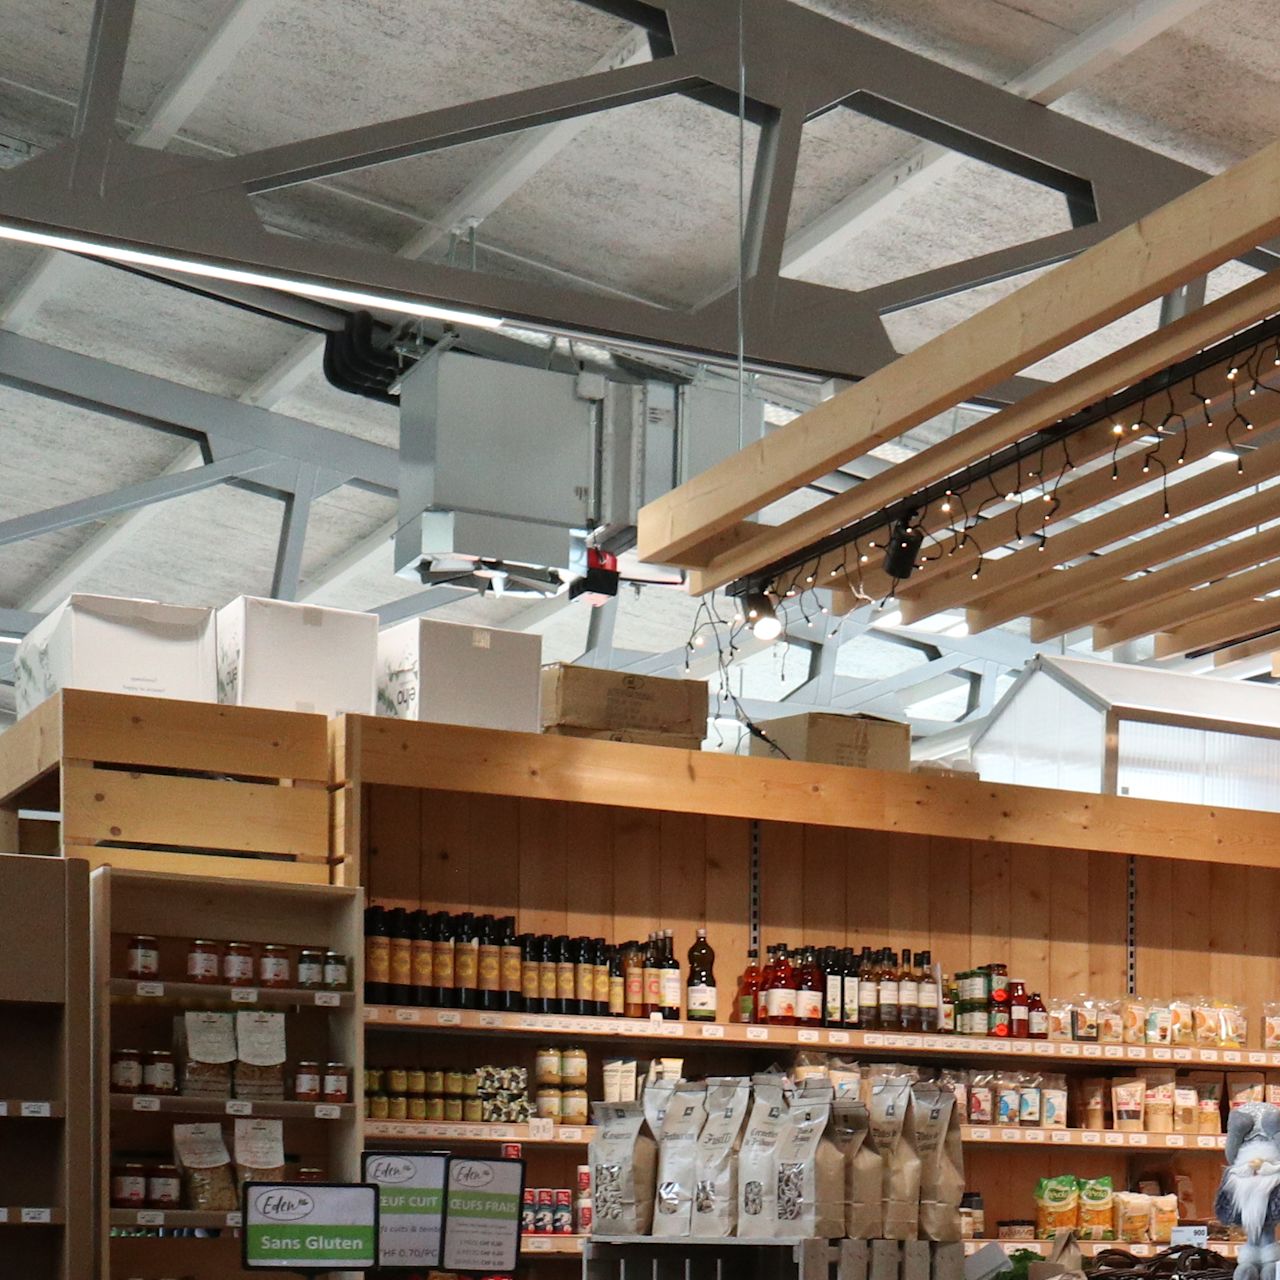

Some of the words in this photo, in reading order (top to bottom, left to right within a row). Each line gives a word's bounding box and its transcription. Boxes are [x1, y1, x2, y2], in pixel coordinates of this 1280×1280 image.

[373, 1164, 400, 1179] Eden
[456, 1166, 482, 1182] Eden
[263, 1197, 299, 1215] Eden
[409, 1196, 438, 1206] CUIT
[485, 1201, 516, 1213] FRAIS
[261, 1236, 301, 1250] Sans
[305, 1235, 363, 1250] Gluten
